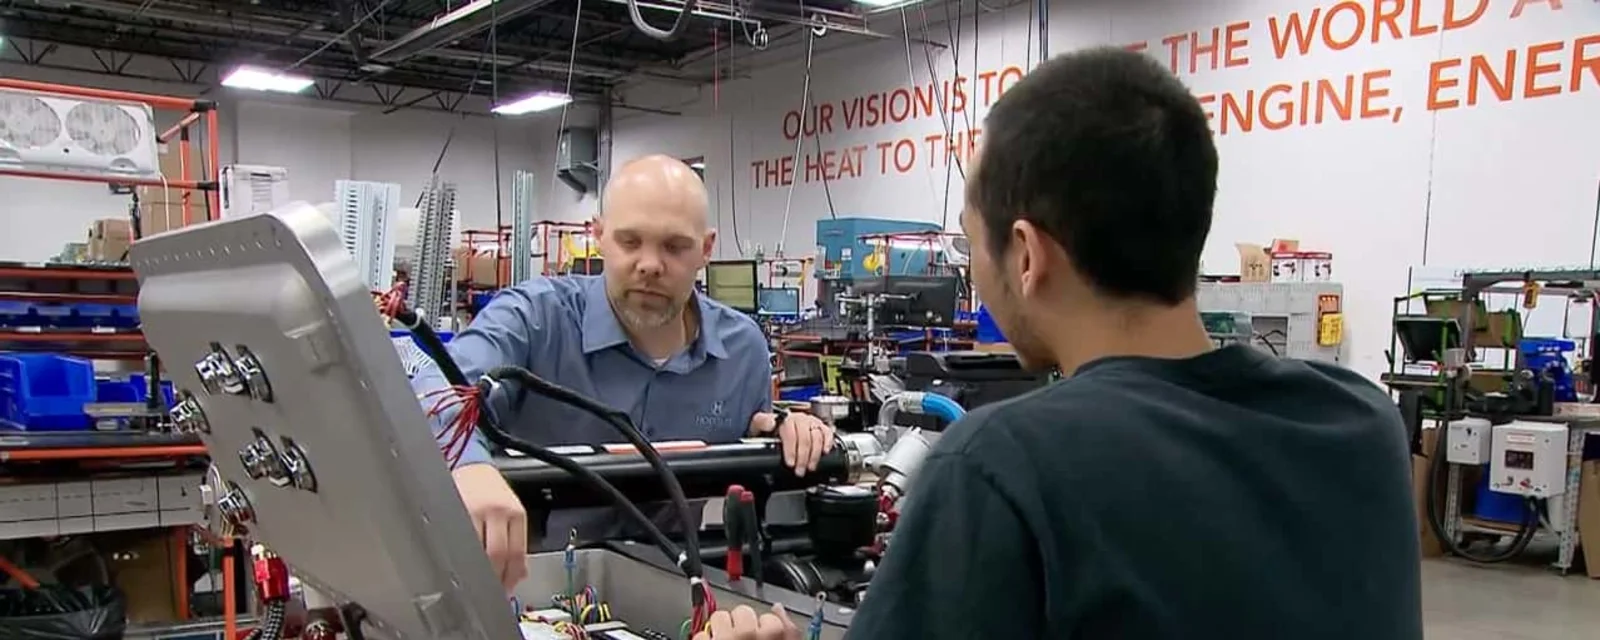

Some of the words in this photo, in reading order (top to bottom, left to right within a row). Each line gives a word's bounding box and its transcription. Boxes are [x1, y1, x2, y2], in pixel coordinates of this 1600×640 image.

[783, 104, 833, 140] OUR
[842, 85, 932, 127] VISION
[943, 76, 967, 113] IS
[1162, 21, 1250, 74] THE
[1268, 0, 1489, 59] WORLD
[752, 157, 793, 189] THE
[805, 146, 867, 182] HEAT
[876, 138, 916, 174] TO
